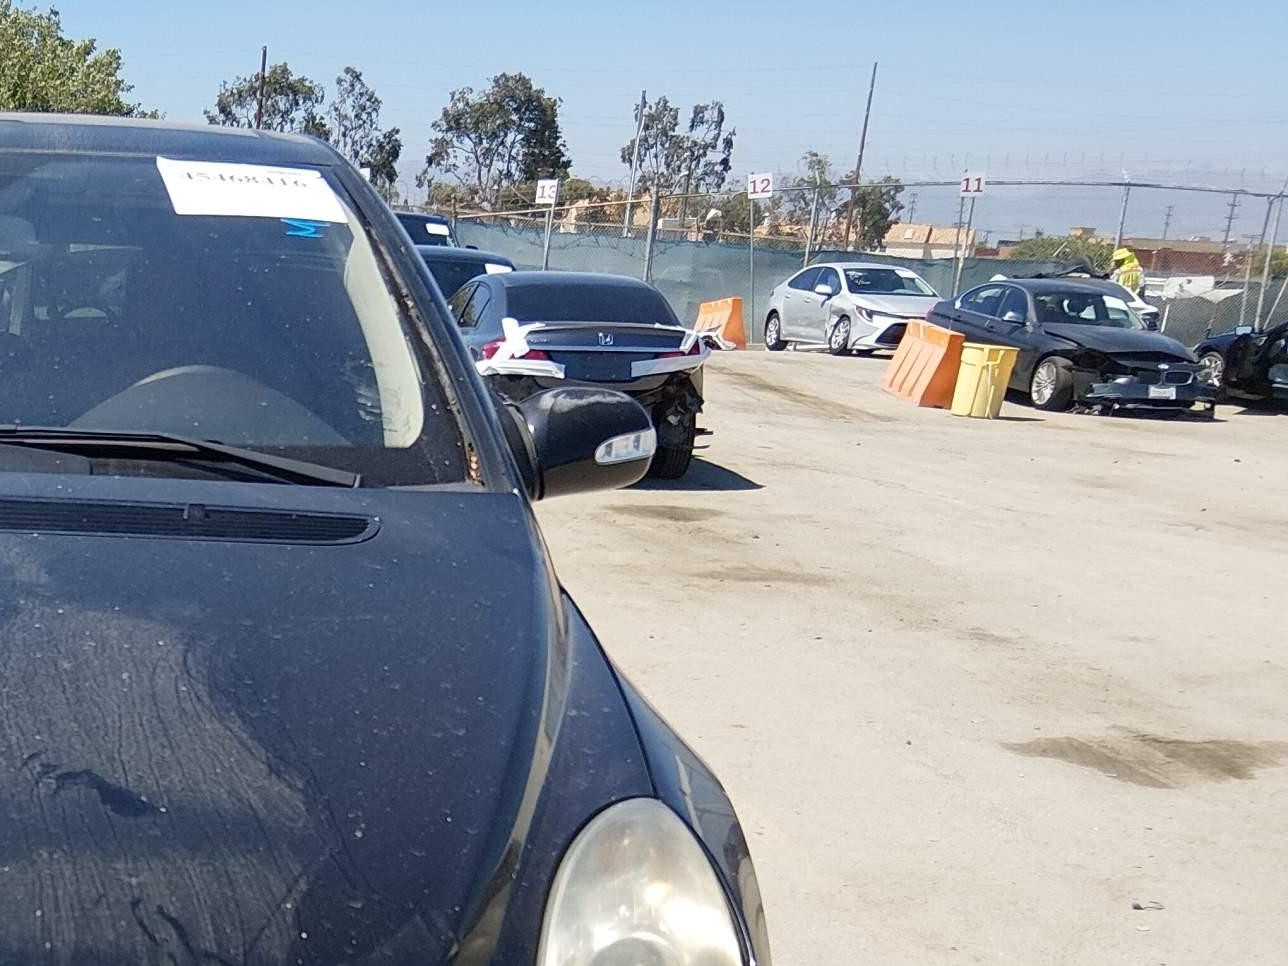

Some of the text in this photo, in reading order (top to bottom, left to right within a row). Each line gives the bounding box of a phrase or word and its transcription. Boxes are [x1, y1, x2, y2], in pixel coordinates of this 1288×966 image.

[537, 185, 556, 199] 13
[749, 178, 770, 194] 12
[961, 177, 983, 193] 11
